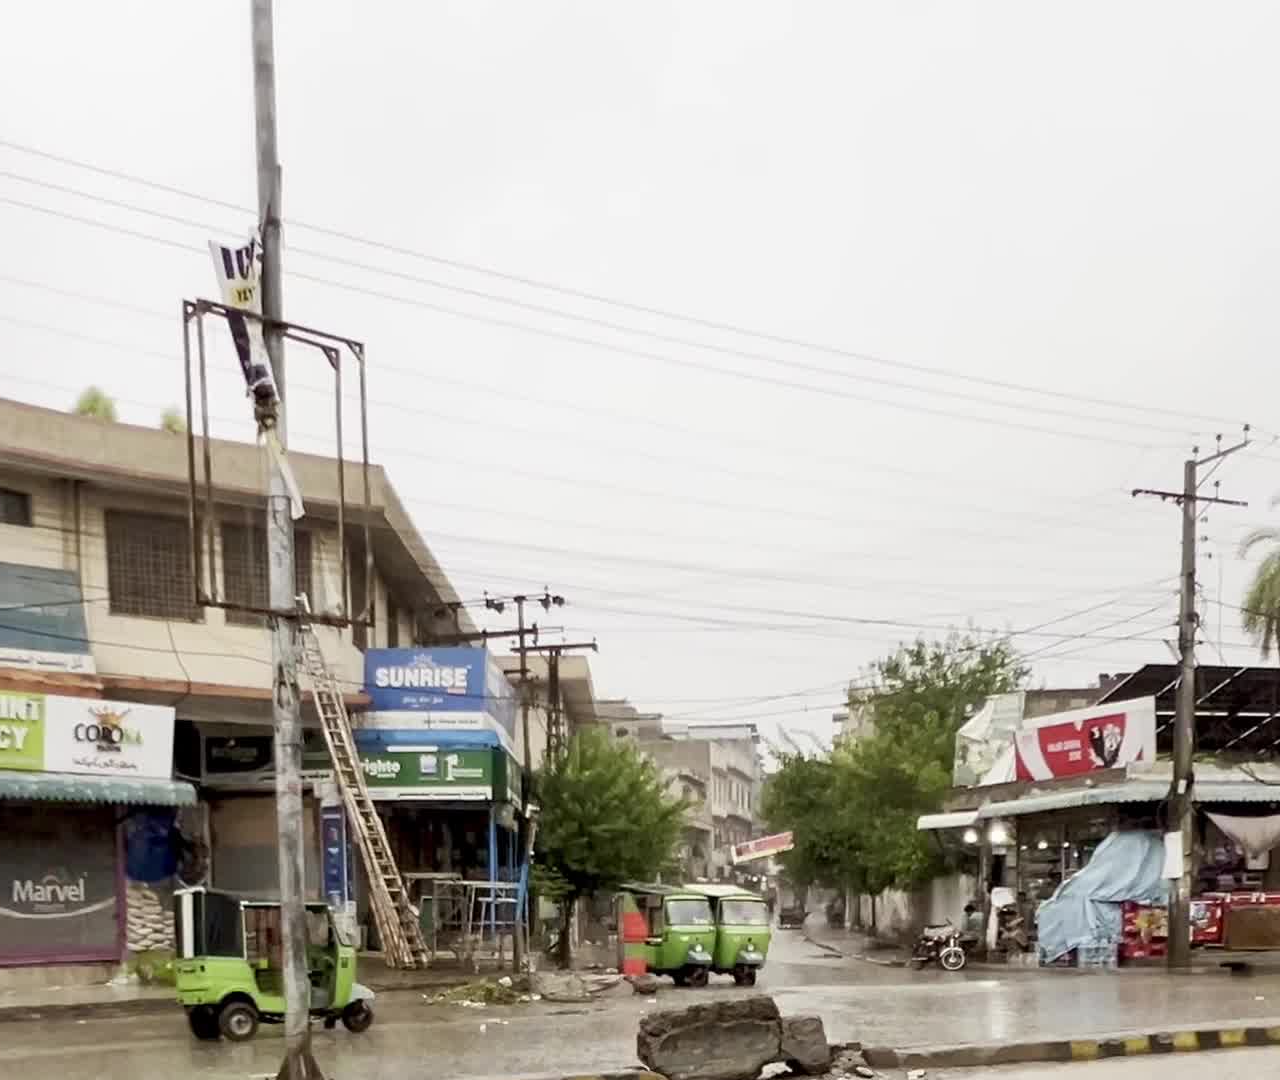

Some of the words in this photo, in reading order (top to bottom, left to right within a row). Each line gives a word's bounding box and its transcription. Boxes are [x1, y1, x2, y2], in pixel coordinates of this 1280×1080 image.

[375, 666, 468, 689] SUNRISE
[359, 760, 401, 777] righto
[12, 879, 85, 902] Marvel
